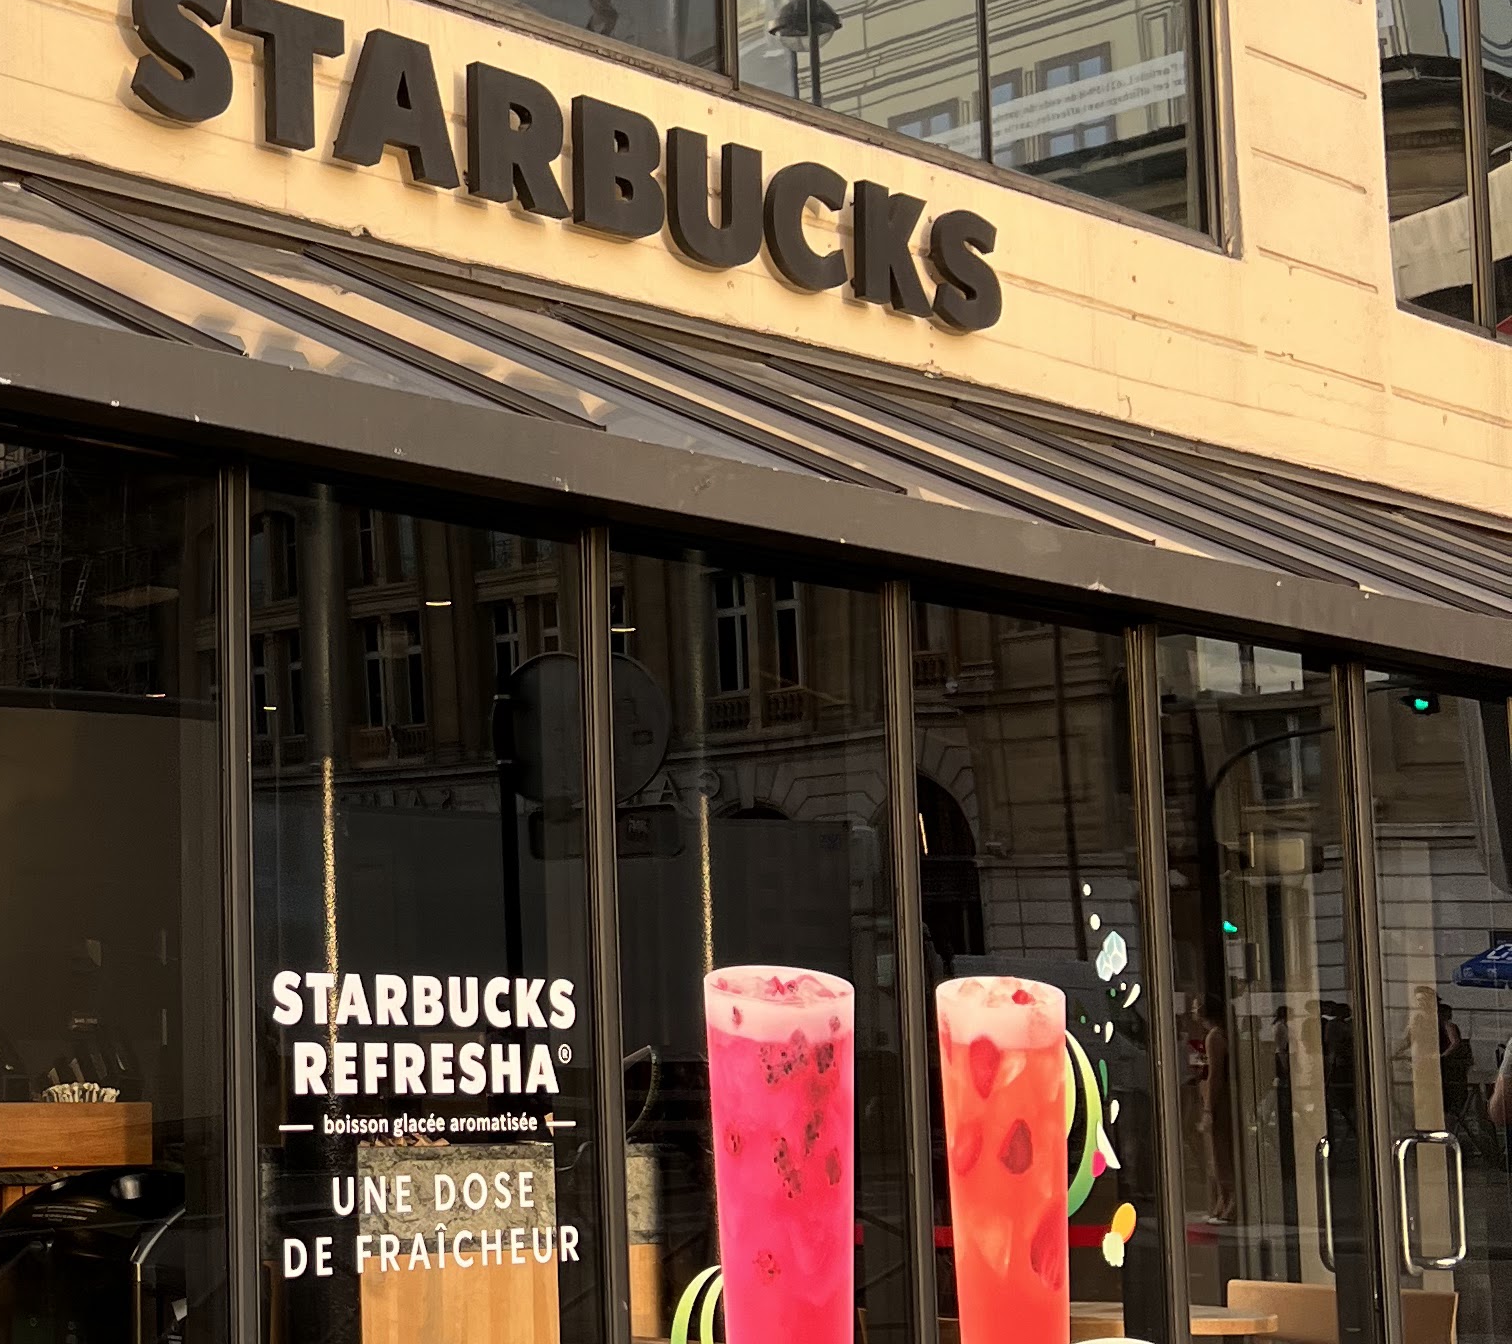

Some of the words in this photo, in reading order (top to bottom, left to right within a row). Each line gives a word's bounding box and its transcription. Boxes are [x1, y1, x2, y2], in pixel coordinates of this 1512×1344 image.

[272, 970, 577, 1030] STARBUCKS
[324, 1114, 389, 1135] boisson
[393, 1112, 446, 1137] glacée
[449, 1112, 538, 1133] aromatisée
[332, 1174, 413, 1217] UNE
[434, 1171, 535, 1212] DOSE
[283, 1237, 334, 1279] DE
[356, 1222, 581, 1275] FRAÎCHEUR
